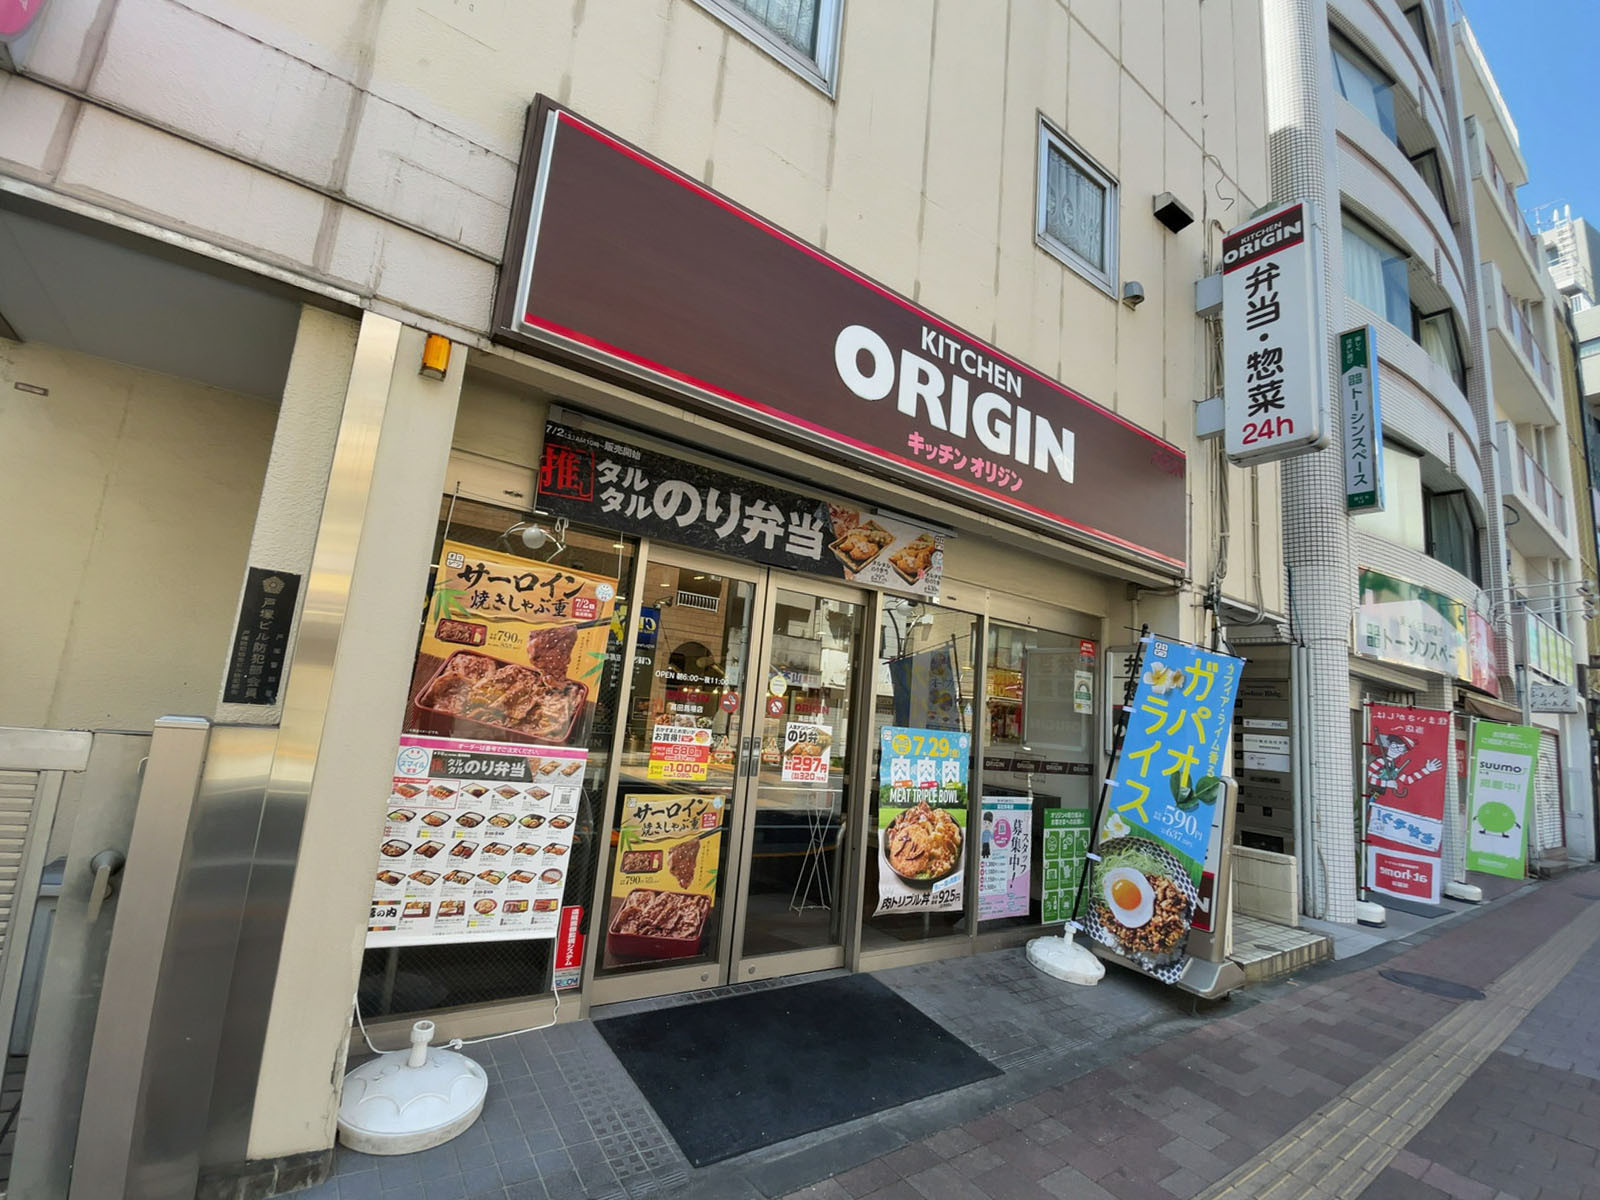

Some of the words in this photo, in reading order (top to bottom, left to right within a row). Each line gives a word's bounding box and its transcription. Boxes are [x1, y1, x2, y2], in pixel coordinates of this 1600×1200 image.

[1223, 220, 1302, 264] ORIGIN
[1240, 220, 1282, 245] KITCHEN
[1244, 262, 1286, 418] 弁当・惣菜
[921, 326, 1023, 399] KITCHEN
[834, 324, 1076, 484] ORIGIN
[1241, 416, 1294, 445] 24h
[1350, 388, 1369, 487] トーシンスペース
[652, 479, 825, 561] のり弁当
[457, 562, 586, 600] サーロイン
[470, 589, 569, 617] 焼きしゃぶ重
[655, 670, 675, 679] OPEN
[787, 729, 818, 743] のり弁
[464, 760, 527, 778] のり弁当
[792, 756, 828, 773] 297円
[1480, 760, 1522, 773] suumo
[889, 788, 912, 803] MEAT
[912, 788, 938, 803] TRIPLE
[938, 789, 959, 803] BOWL
[633, 798, 710, 823] サーロイン
[1020, 833, 1030, 874] スタッフ
[880, 892, 930, 910] 肉トリプル丼
[938, 889, 961, 904] 925円
